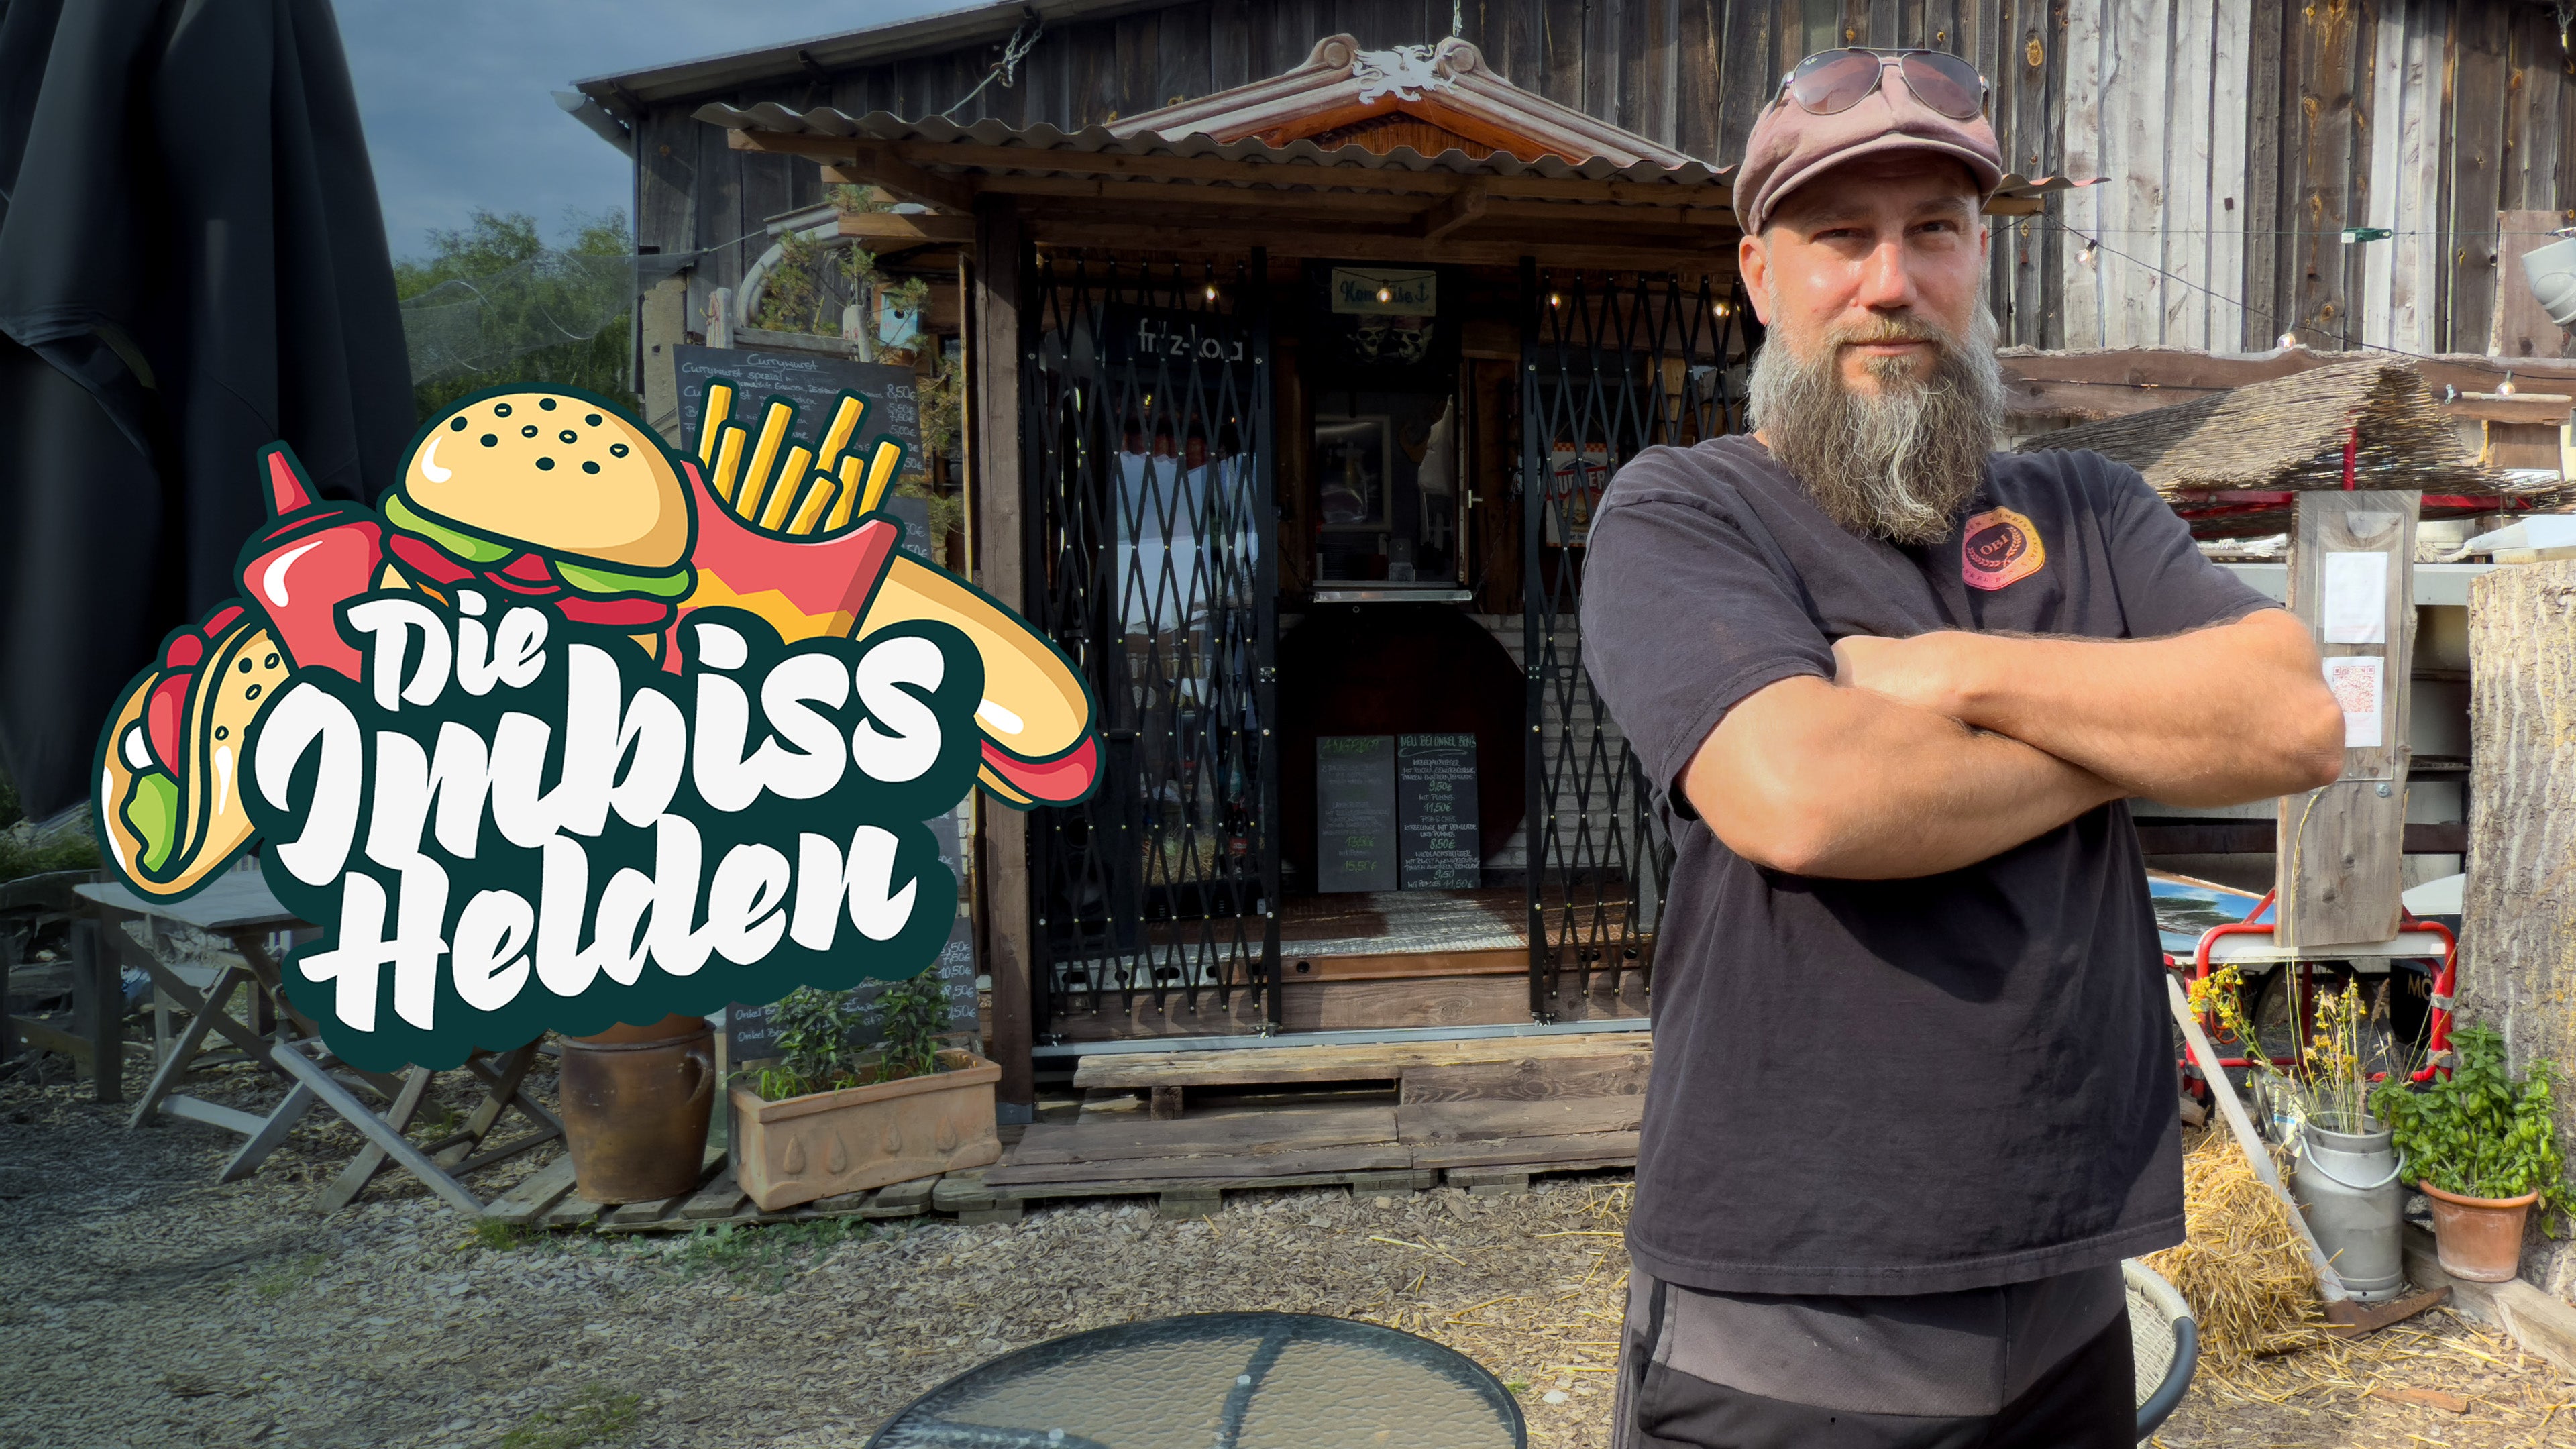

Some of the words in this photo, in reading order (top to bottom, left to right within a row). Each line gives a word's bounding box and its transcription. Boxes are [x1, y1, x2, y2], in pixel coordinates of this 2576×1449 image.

[747, 354, 818, 374] Currywurst
[682, 362, 743, 378] Currywurst
[747, 371, 783, 382] spezial
[887, 384, 917, 402] 8,50€
[889, 425, 916, 437] 5,00€
[903, 458, 924, 470] ,50€
[1980, 533, 2009, 555] OBI
[1400, 735, 1417, 747] NEU
[1428, 780, 1452, 792] 9,50€
[1423, 802, 1452, 813] 11,50€
[1430, 838, 1456, 849] 8,50€
[1433, 869, 1455, 880] 9,50
[1444, 879, 1474, 889] 11,50€
[938, 965, 972, 979] 10,50€
[735, 1007, 762, 1020] Onkel
[738, 1029, 764, 1042] Onkel
